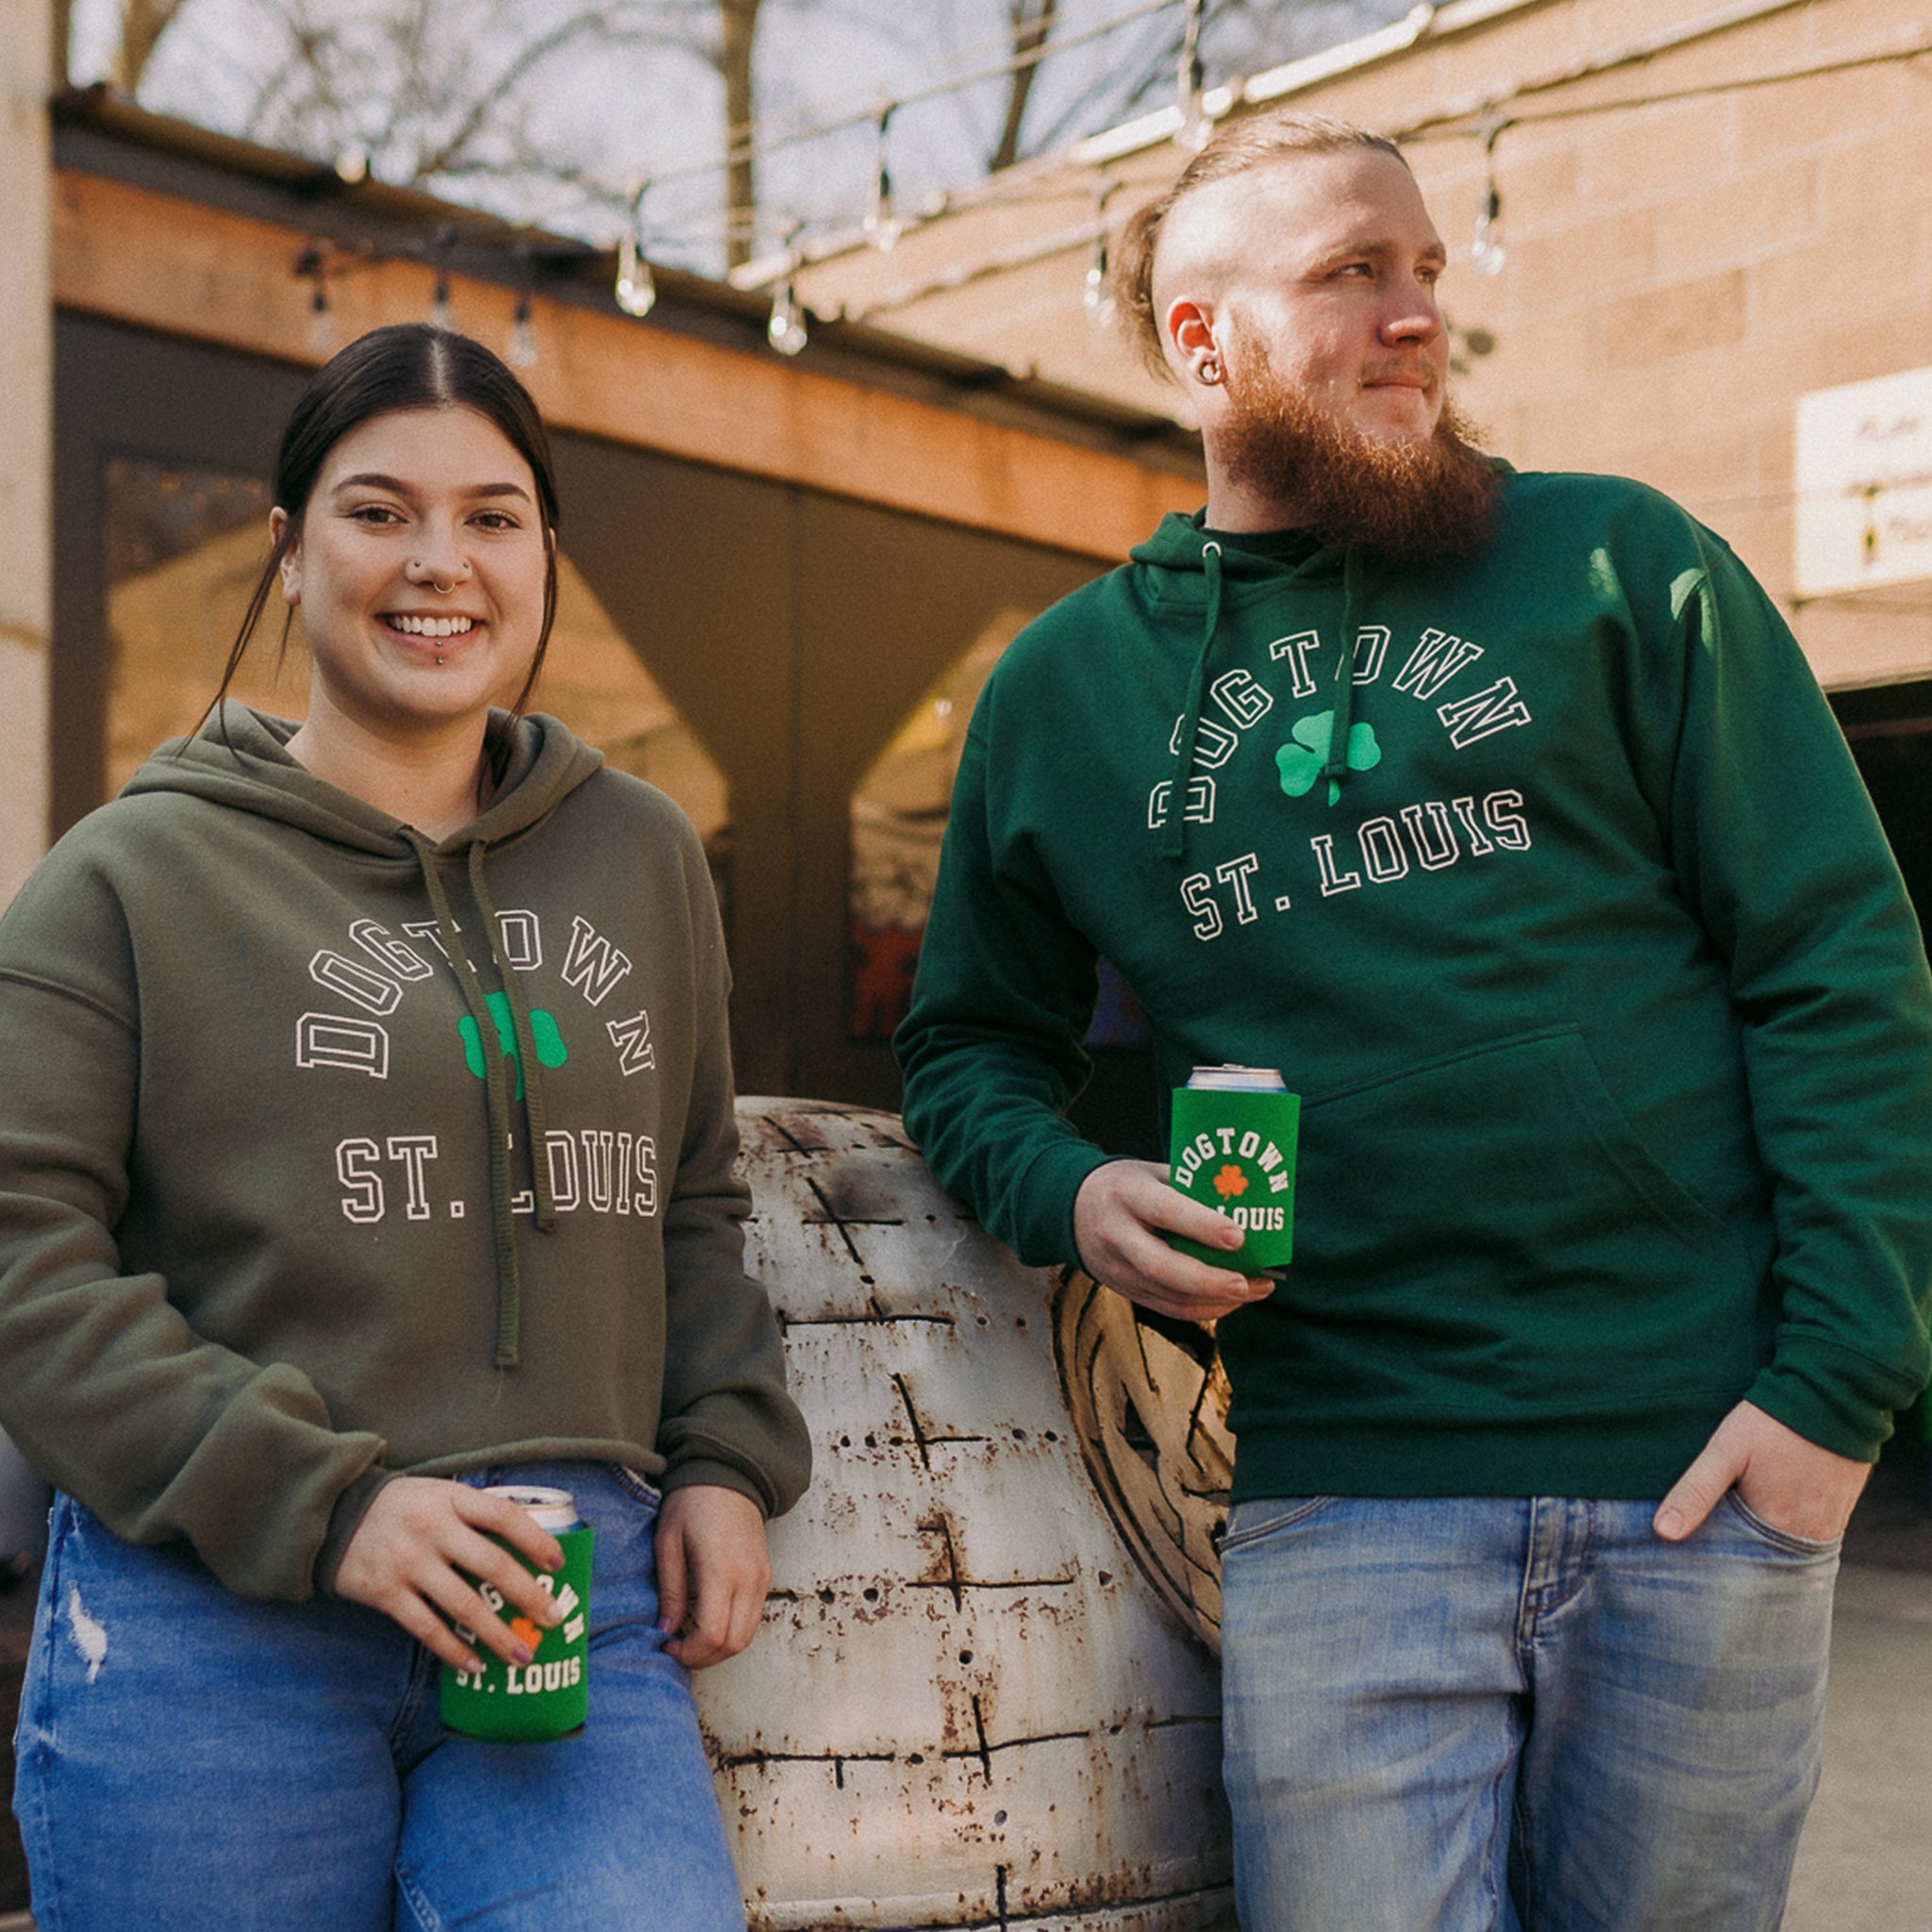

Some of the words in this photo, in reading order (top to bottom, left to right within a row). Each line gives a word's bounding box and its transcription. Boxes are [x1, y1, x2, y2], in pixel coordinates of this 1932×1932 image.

[1148, 625, 1531, 829] DOGTOWN
[1180, 853, 1291, 941] ST.
[1310, 789, 1532, 897] LOUIS
[335, 1135, 465, 1224] ST.
[1175, 1127, 1290, 1194] DOGTOWN
[507, 1656, 581, 1694] LOUIS
